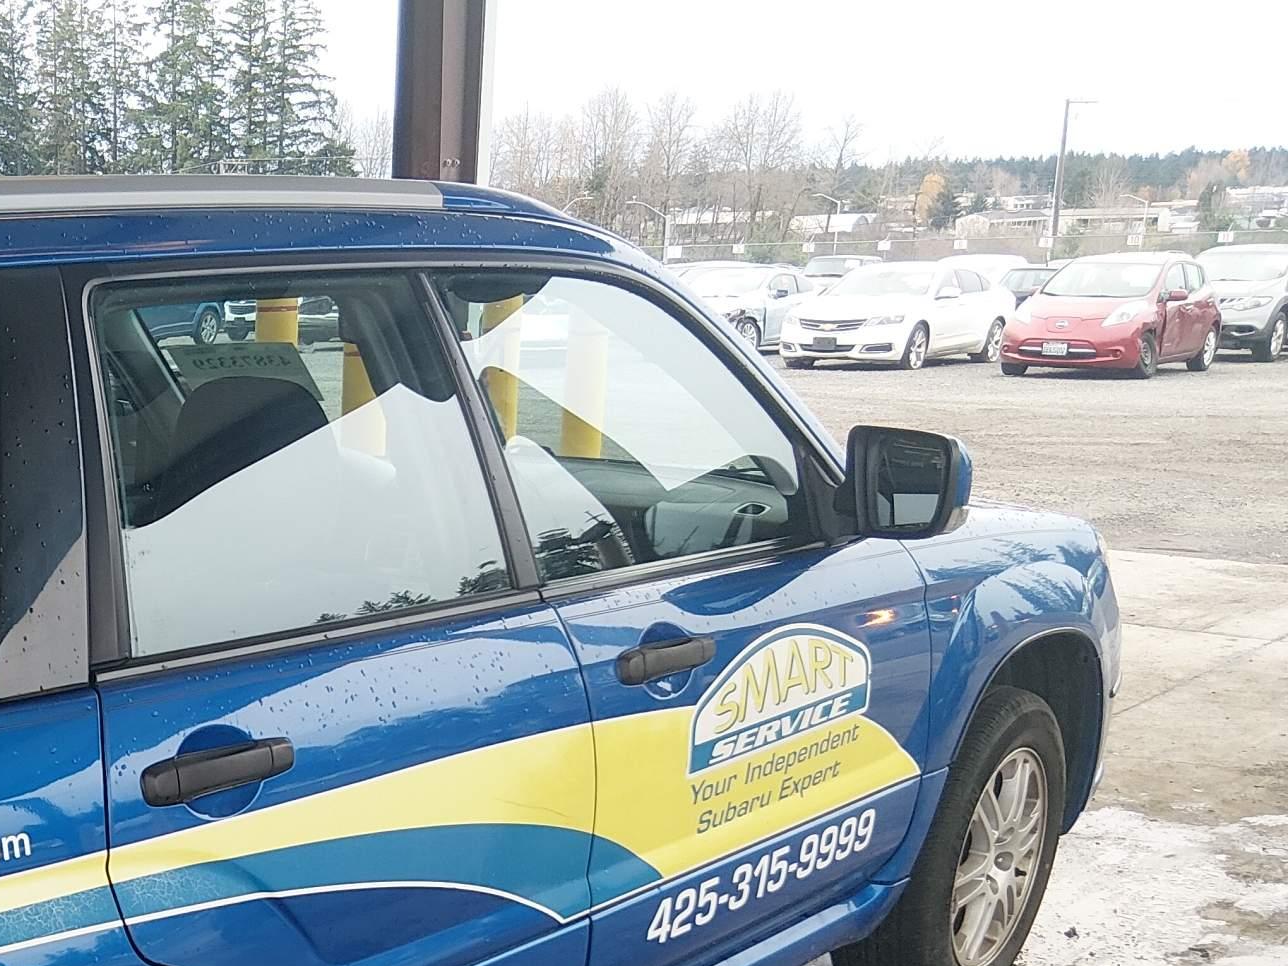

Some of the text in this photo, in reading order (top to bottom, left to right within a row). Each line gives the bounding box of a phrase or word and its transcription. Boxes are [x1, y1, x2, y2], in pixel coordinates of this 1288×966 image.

[714, 638, 854, 735] SMART
[690, 723, 860, 805] Your Independent
[708, 692, 853, 765] SERVICE
[696, 760, 841, 835] Subaru Expert
[645, 808, 877, 944] 425-315-9999
